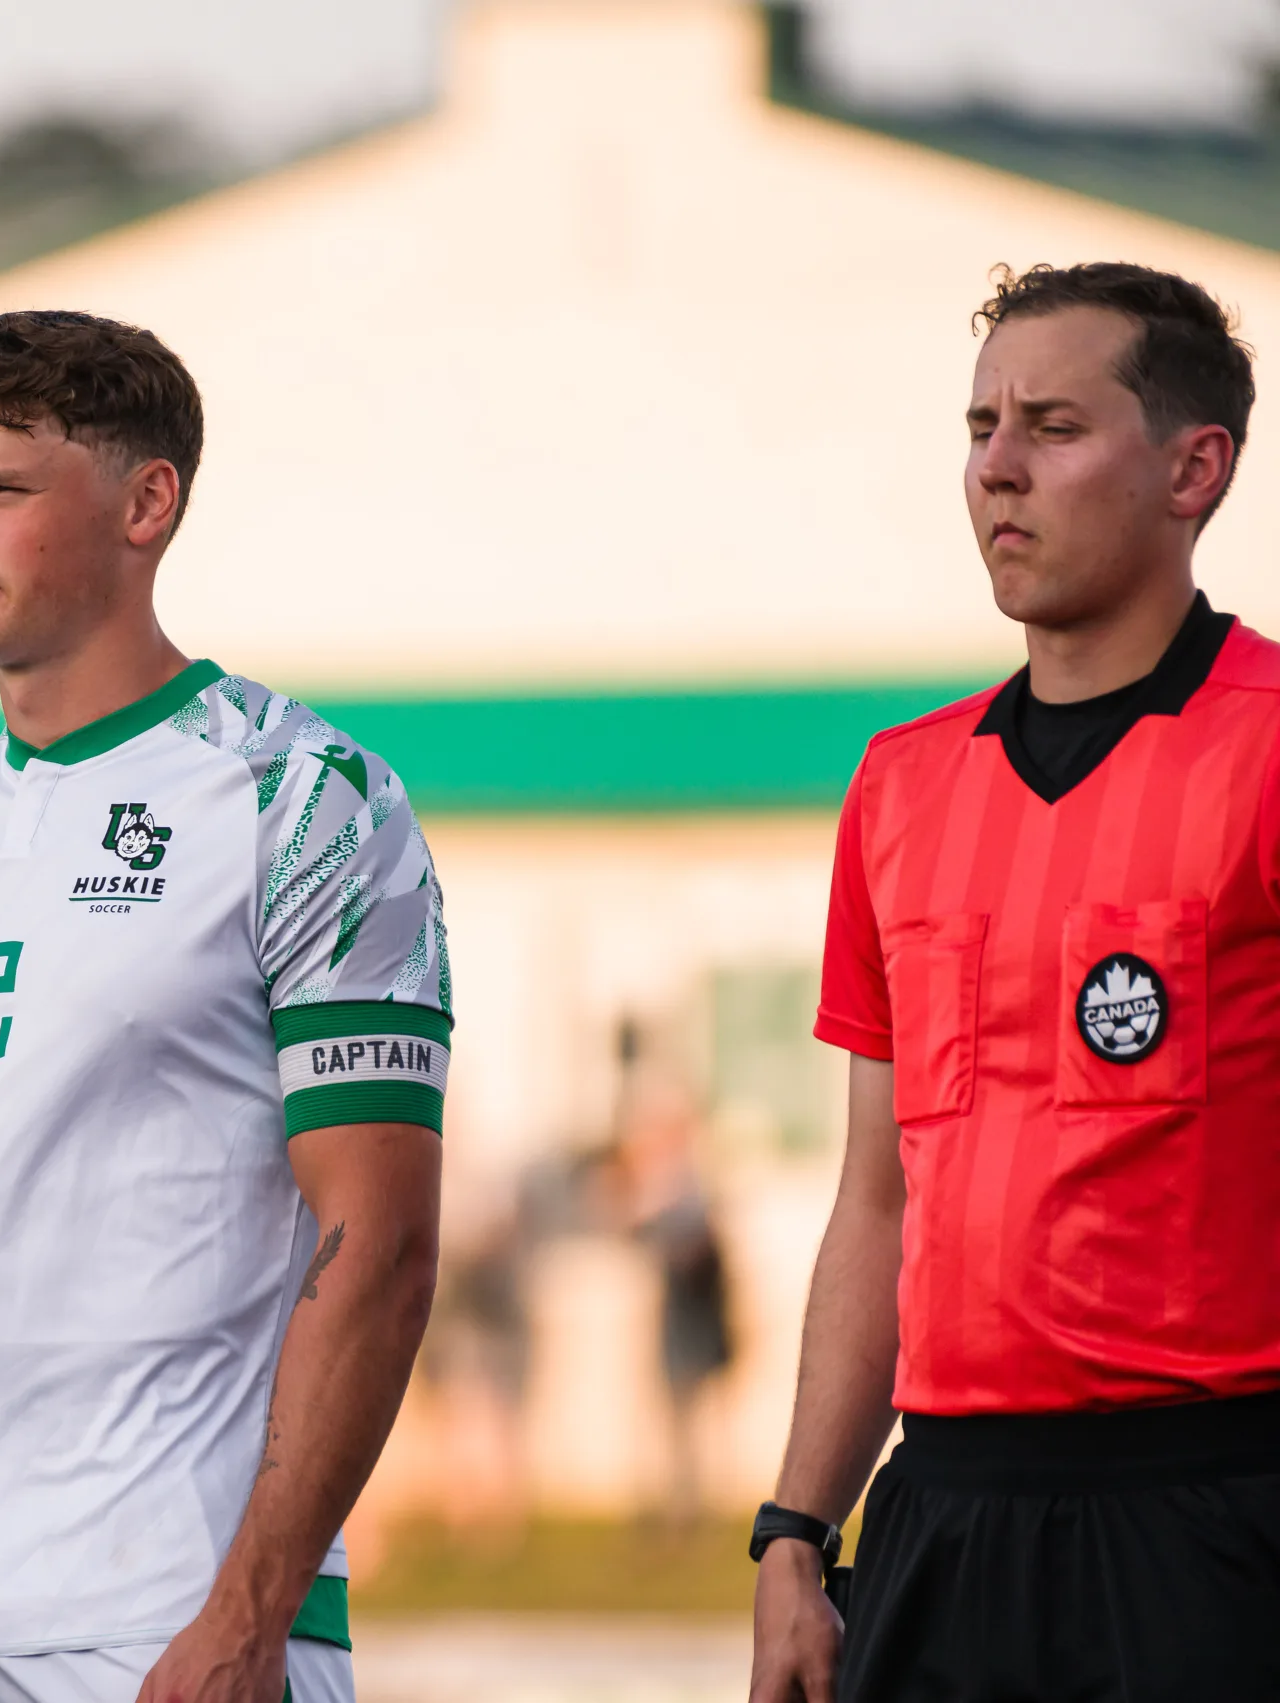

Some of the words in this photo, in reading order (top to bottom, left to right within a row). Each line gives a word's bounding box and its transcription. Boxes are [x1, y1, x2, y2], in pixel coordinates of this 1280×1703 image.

[73, 877, 166, 895] HUSKIE
[89, 904, 131, 913] SOCCER
[1084, 996, 1160, 1024] CANADA
[311, 1040, 432, 1075] CAPTAIN
